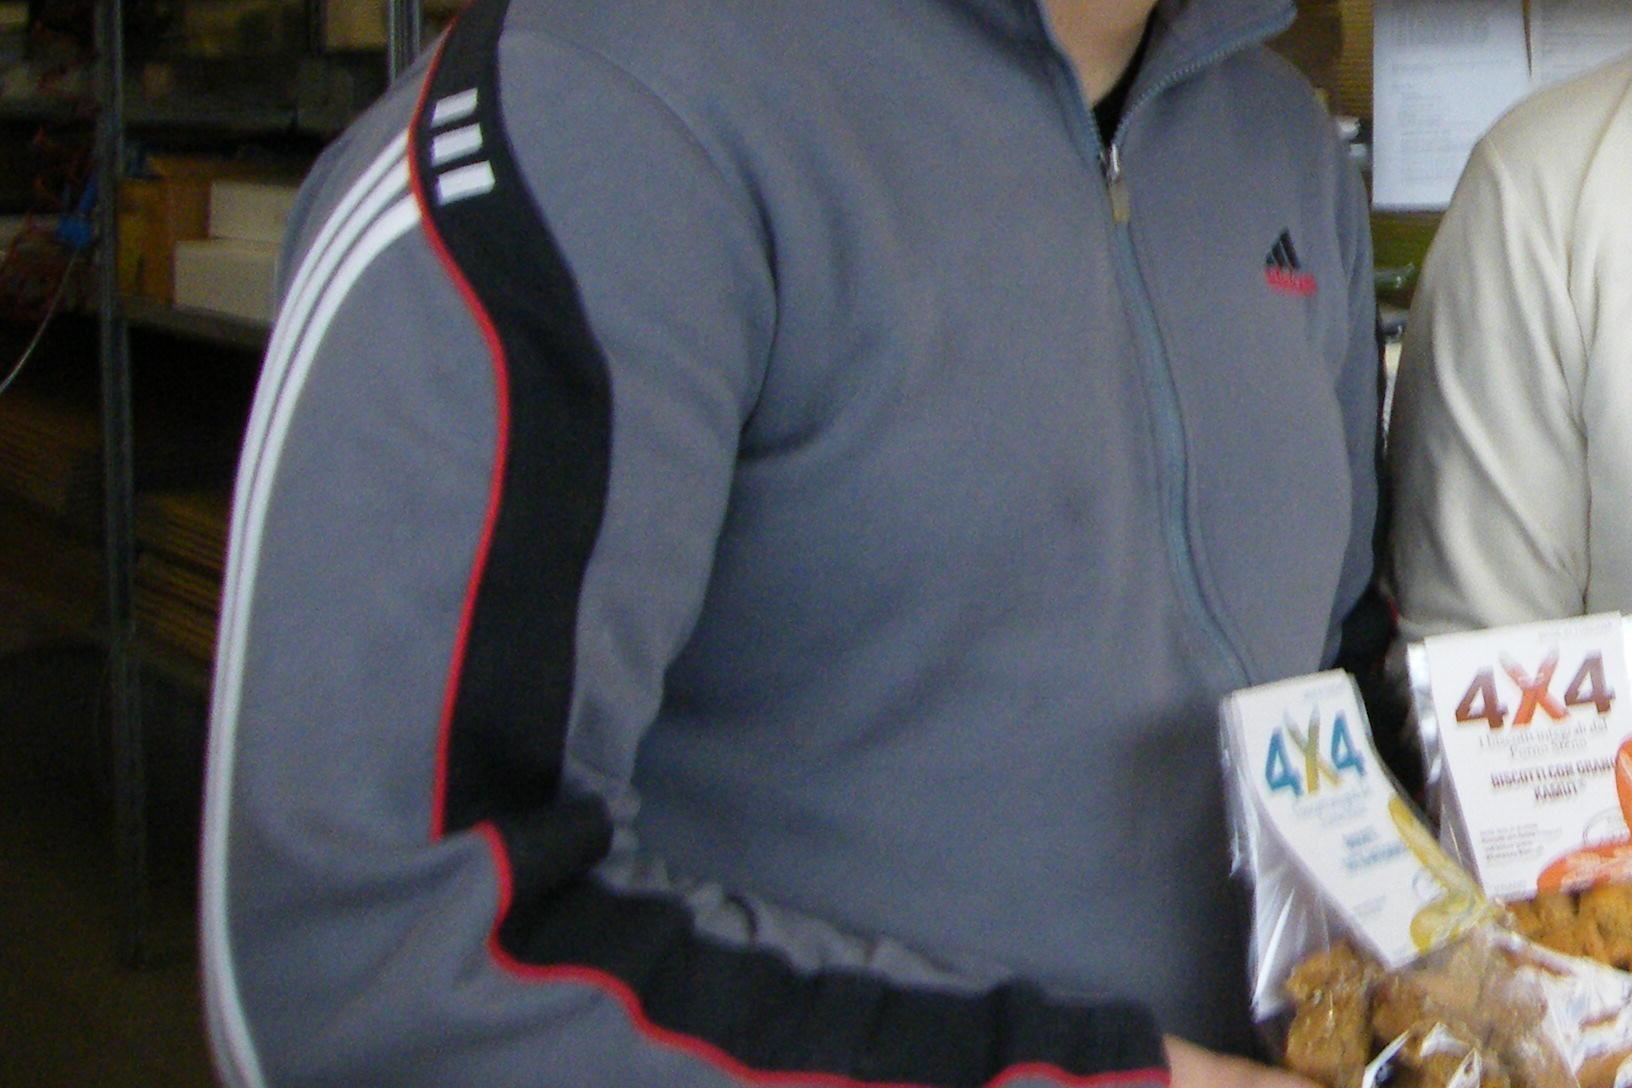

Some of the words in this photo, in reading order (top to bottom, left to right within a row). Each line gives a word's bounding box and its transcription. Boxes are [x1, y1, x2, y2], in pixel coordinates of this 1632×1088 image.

[1455, 645, 1616, 731] 4X4
[1264, 703, 1368, 797] 4X4
[1490, 768, 1547, 788] BISCOTTI
[1548, 761, 1574, 779] CON
